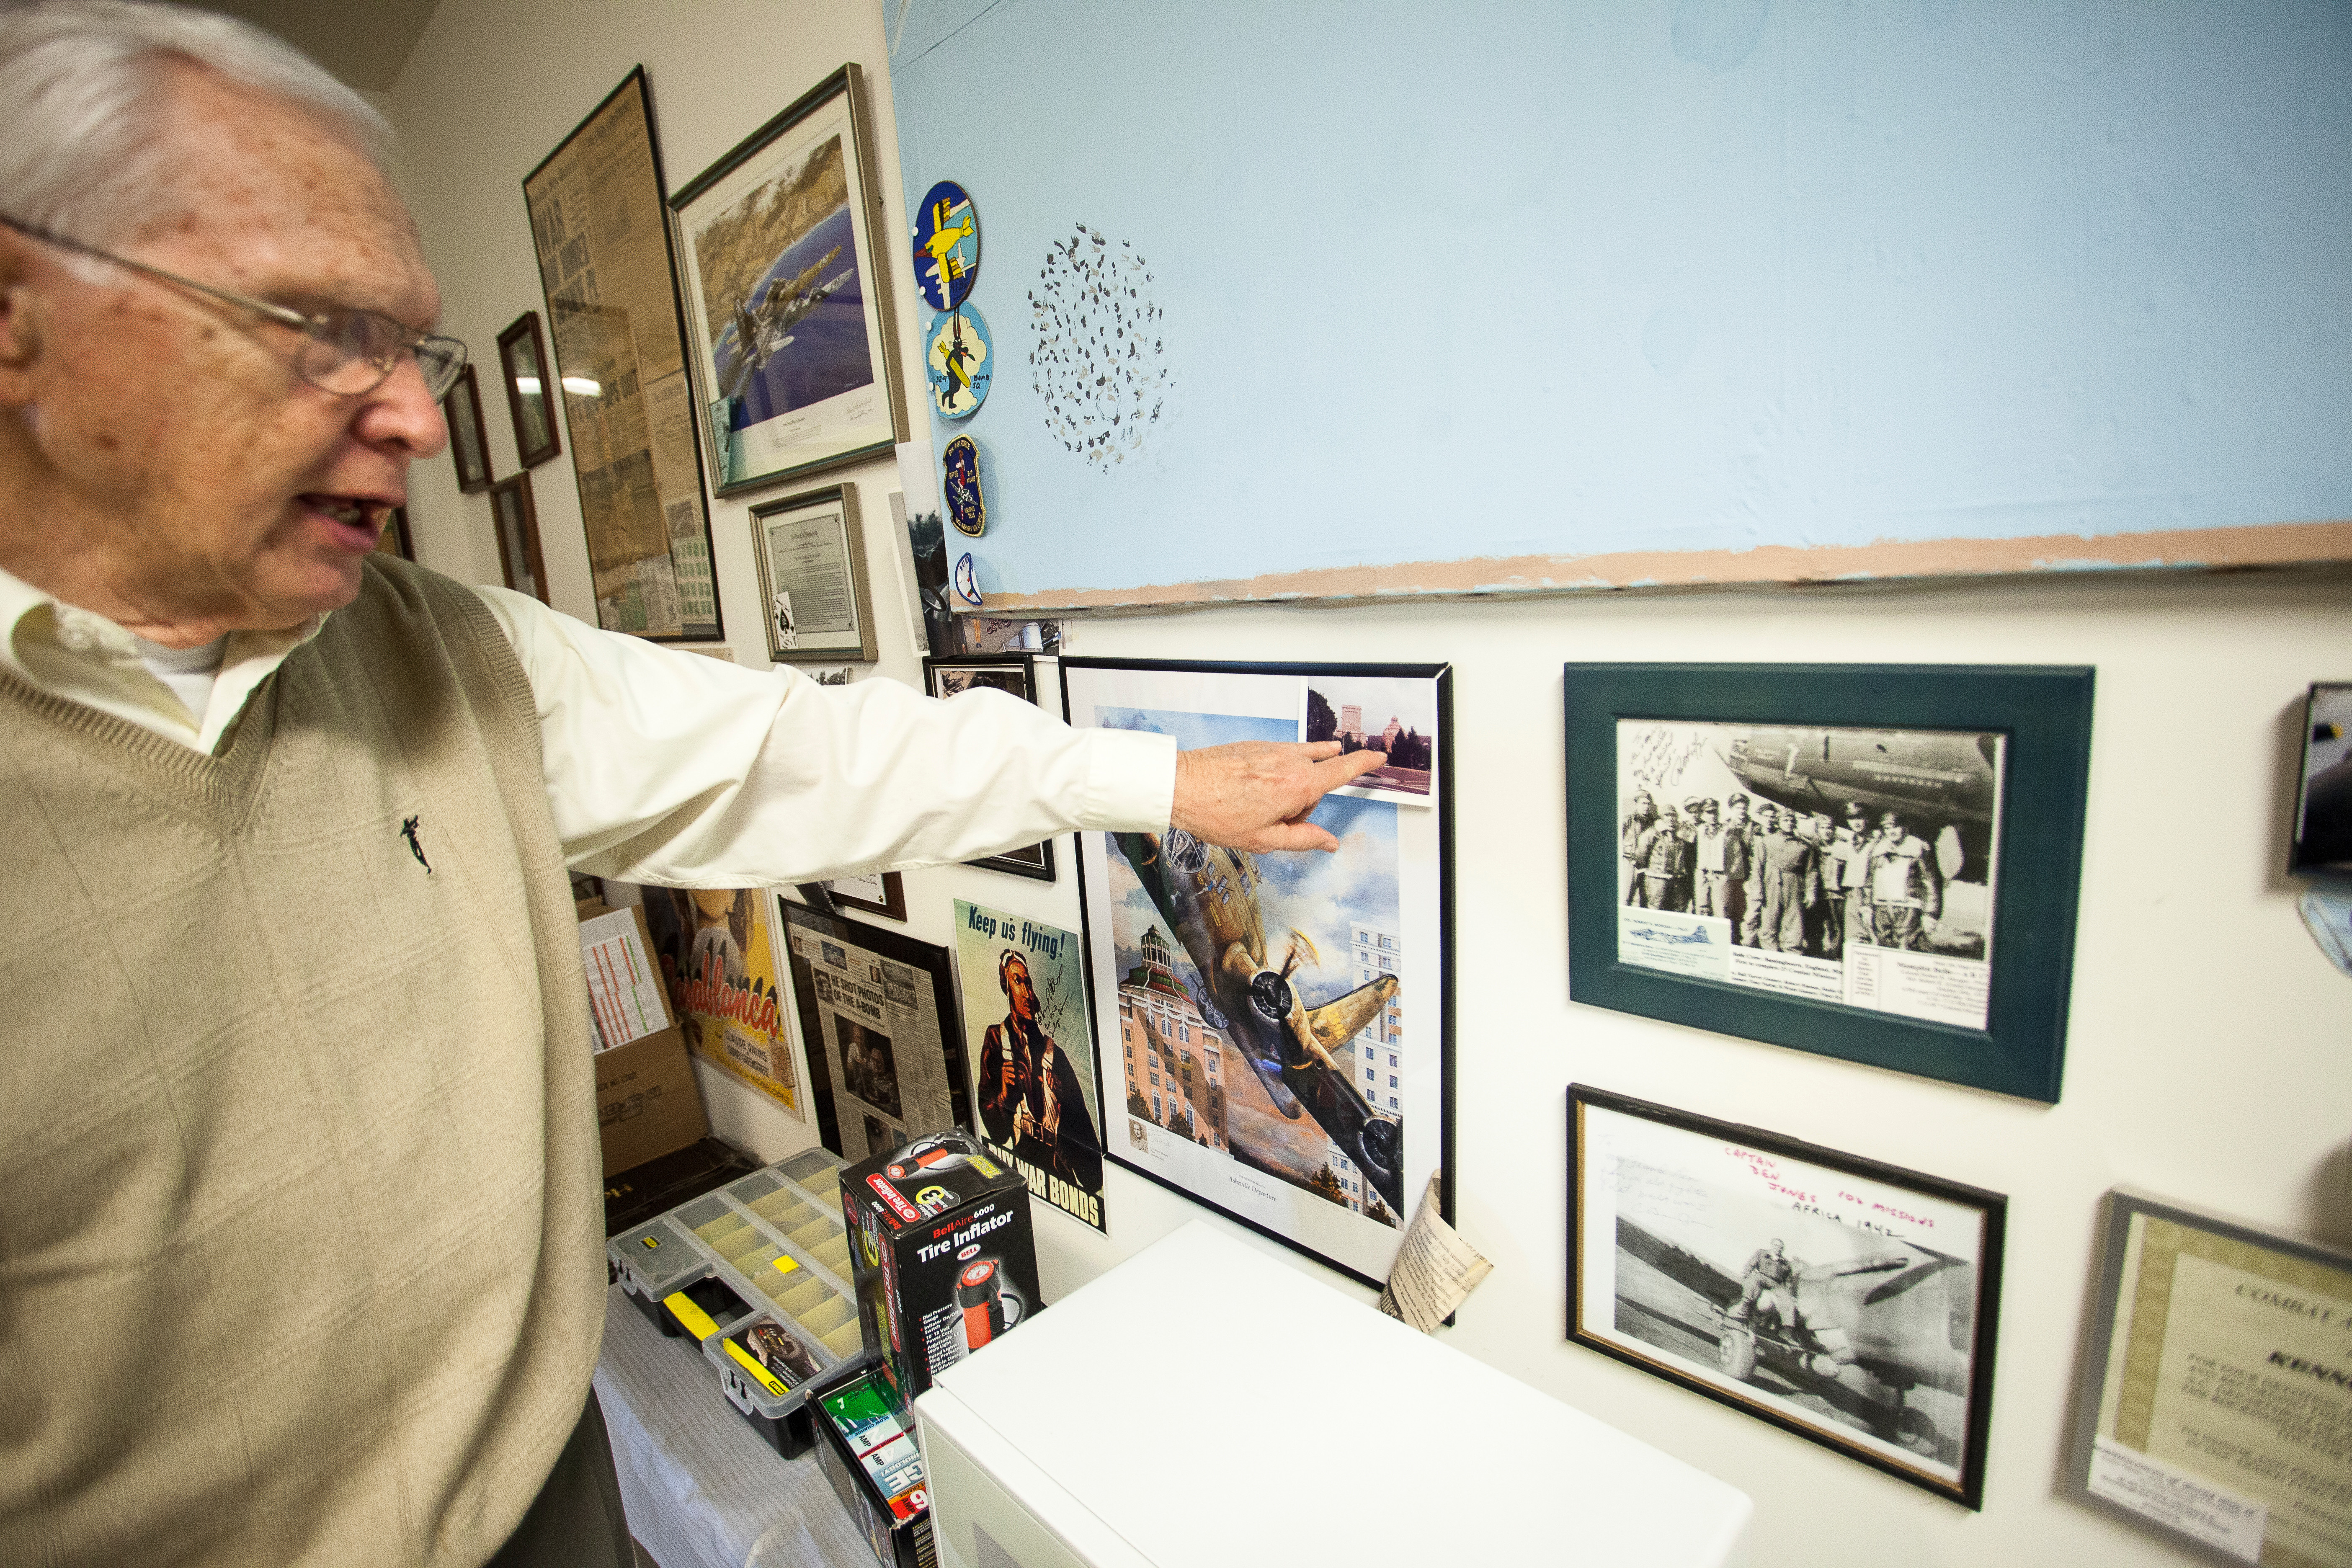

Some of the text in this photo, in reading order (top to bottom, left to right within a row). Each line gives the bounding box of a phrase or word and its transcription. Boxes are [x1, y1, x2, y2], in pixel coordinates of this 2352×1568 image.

[960, 440, 971, 450] FORCE
[968, 905, 1066, 960] Keep us flying!
[830, 974, 885, 1006] HE SHOT PHOTOS
[833, 989, 881, 1019] OF THE A-BOMB
[873, 1178, 897, 1200] Inflator
[1016, 1160, 1047, 1200] WAR
[1049, 1175, 1099, 1227] BONDS
[1228, 1176, 1277, 1202] Asheville Departure
[871, 1201, 885, 1213] 6000
[893, 1197, 908, 1212] Tire
[1792, 1202, 1841, 1222] AFRICA
[933, 1203, 995, 1239] BellAire 6000
[917, 1210, 1014, 1264] Tire Inflator
[961, 1246, 978, 1258] BELL
[933, 1303, 952, 1315] Pressure
[2235, 1283, 2334, 1324] COMBAT
[886, 1290, 898, 1341] Inflator
[923, 1315, 939, 1325] Gauge
[924, 1310, 959, 1330] Inflator On/Off
[925, 1325, 941, 1335] Switch
[926, 1329, 953, 1345] Power Cord
[927, 1336, 952, 1350] Adjustable
[928, 1340, 951, 1354] Work Light
[928, 1351, 942, 1360] Fused
[769, 1382, 784, 1395] STANLEY
[875, 1416, 889, 1425] SLOW
[859, 1426, 885, 1447] 2 AMP
[871, 1447, 895, 1466] 4 AMP
[901, 1489, 928, 1513] 6 AMP
